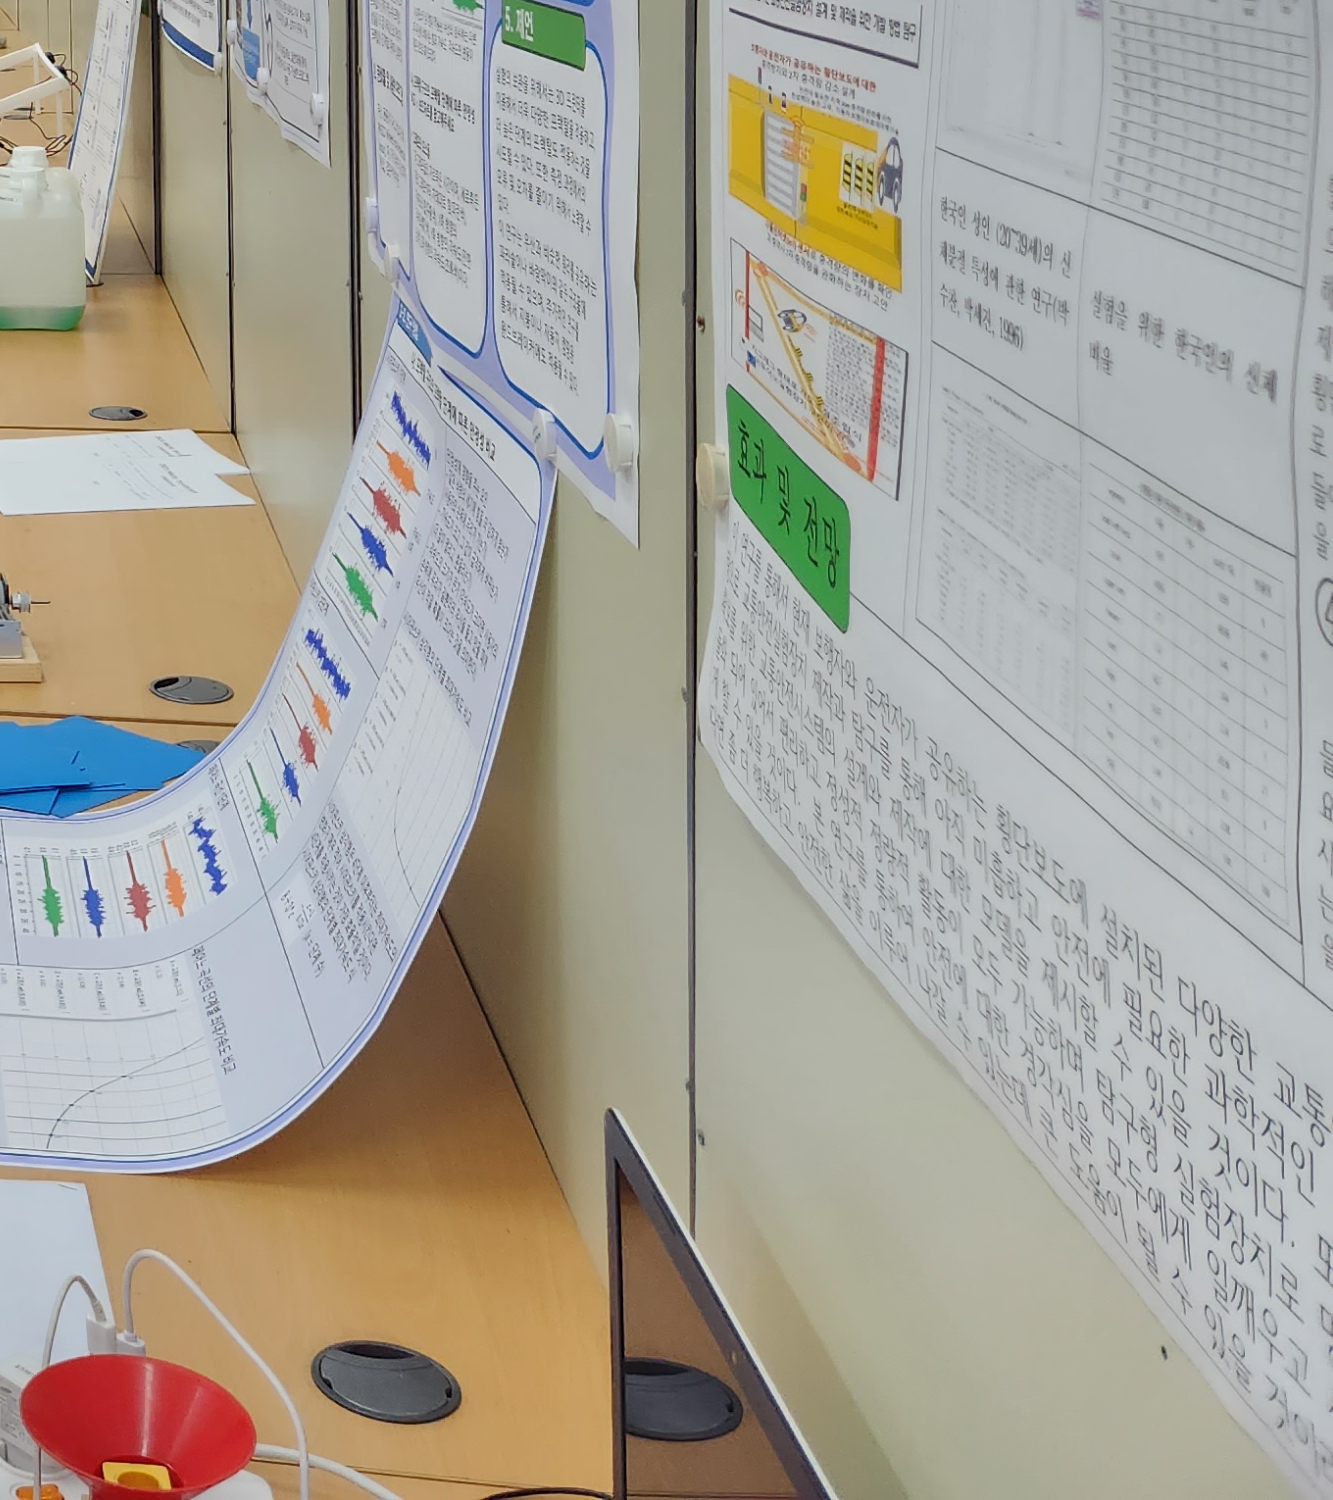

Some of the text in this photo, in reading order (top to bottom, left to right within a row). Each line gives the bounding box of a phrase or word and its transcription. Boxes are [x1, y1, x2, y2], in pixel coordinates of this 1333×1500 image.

[736, 421, 768, 494] 효과
[803, 494, 841, 589] 전망
[925, 734, 988, 831] 공유하는
[995, 803, 1089, 932] 횡단보도에
[1100, 902, 1165, 1003] 설치된
[1177, 975, 1258, 1085] 다양한
[1011, 978, 1085, 1094] 가능하며
[1095, 1067, 1159, 1173] 탐구형
[1173, 1152, 1306, 1325] 실험장치로
[1050, 913, 1111, 1009] 안전에
[1122, 981, 1189, 1089] 필요한
[1204, 1063, 1316, 1208] 과학적인
[1109, 1031, 1133, 1083] 수
[1144, 1065, 1192, 1150] 있을
[1206, 1124, 1295, 1249] 것이다.
[1106, 1136, 1192, 1272] 모두에게
[1205, 1249, 1312, 1399] 일깨우고
[1170, 1266, 1194, 1317] 수
